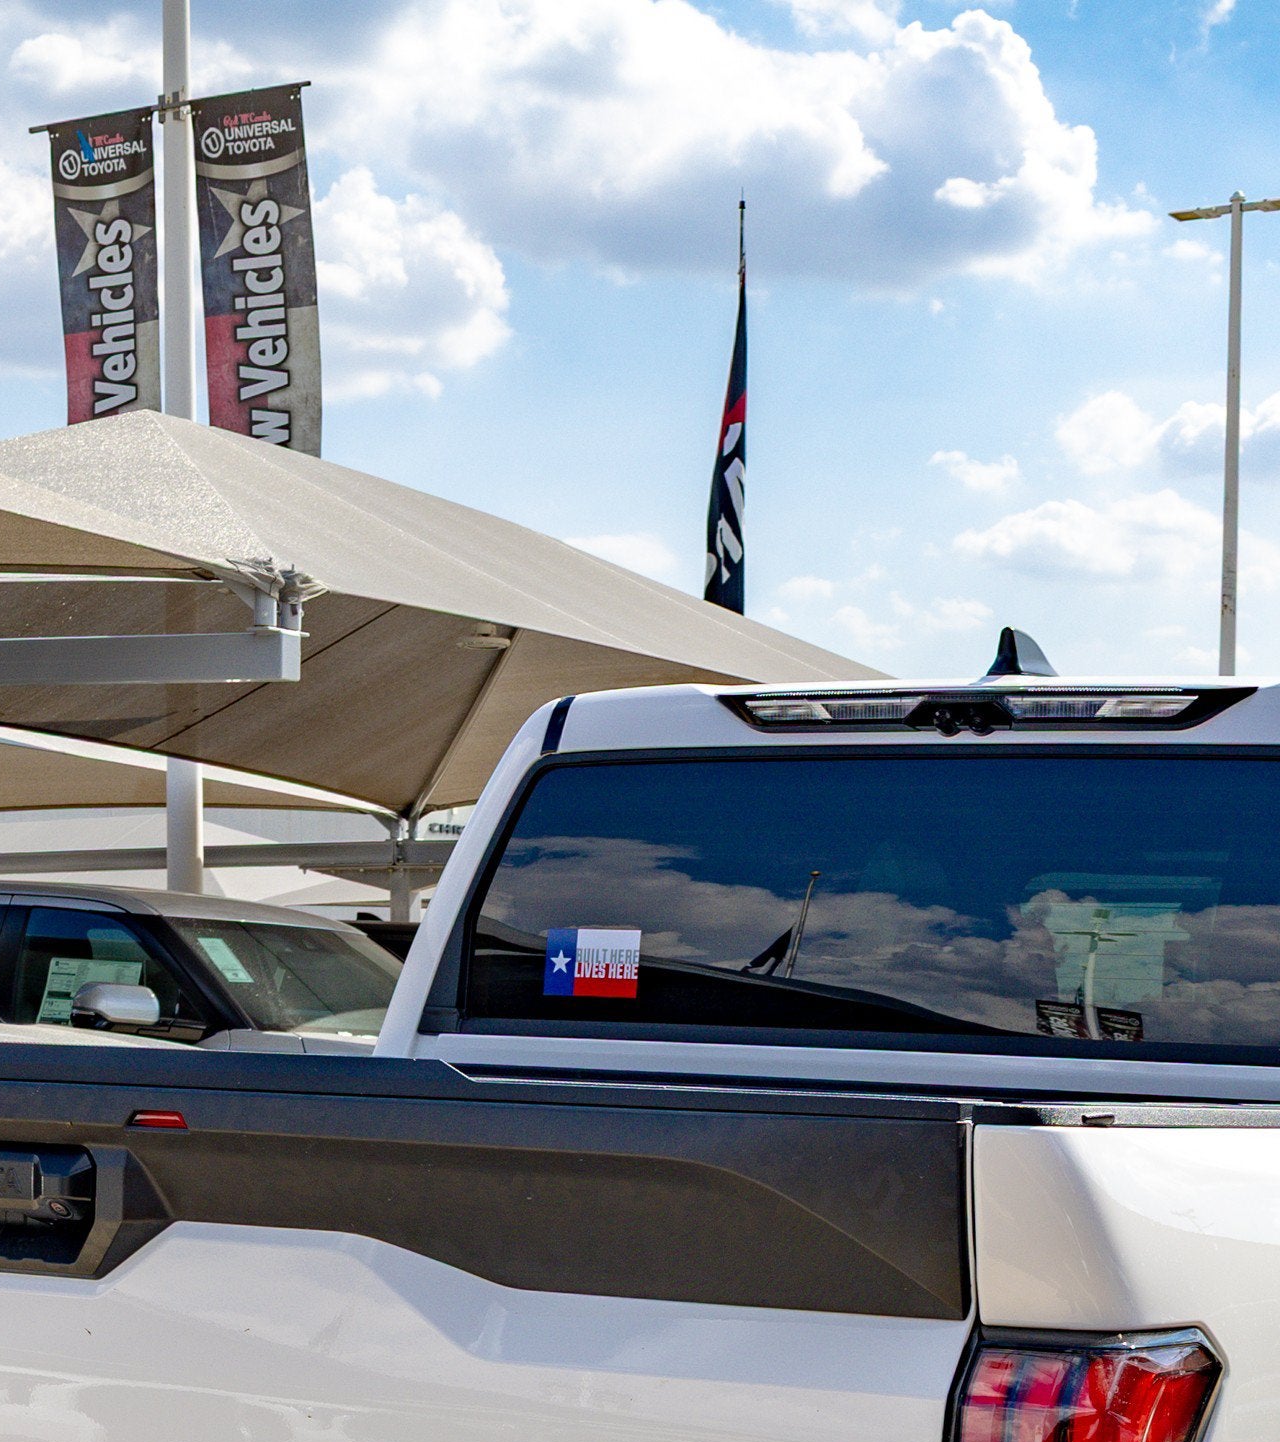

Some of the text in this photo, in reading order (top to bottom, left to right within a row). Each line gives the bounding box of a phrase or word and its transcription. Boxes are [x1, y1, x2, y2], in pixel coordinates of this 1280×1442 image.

[224, 119, 296, 140] UNIVERSAL
[226, 137, 275, 155] TOYOTA
[81, 158, 126, 176] TOYOTA
[233, 199, 289, 400] Vehicles
[89, 218, 137, 415] Vehicles
[576, 948, 640, 964] BUILT HERE
[574, 962, 638, 979] LIVES HERE
